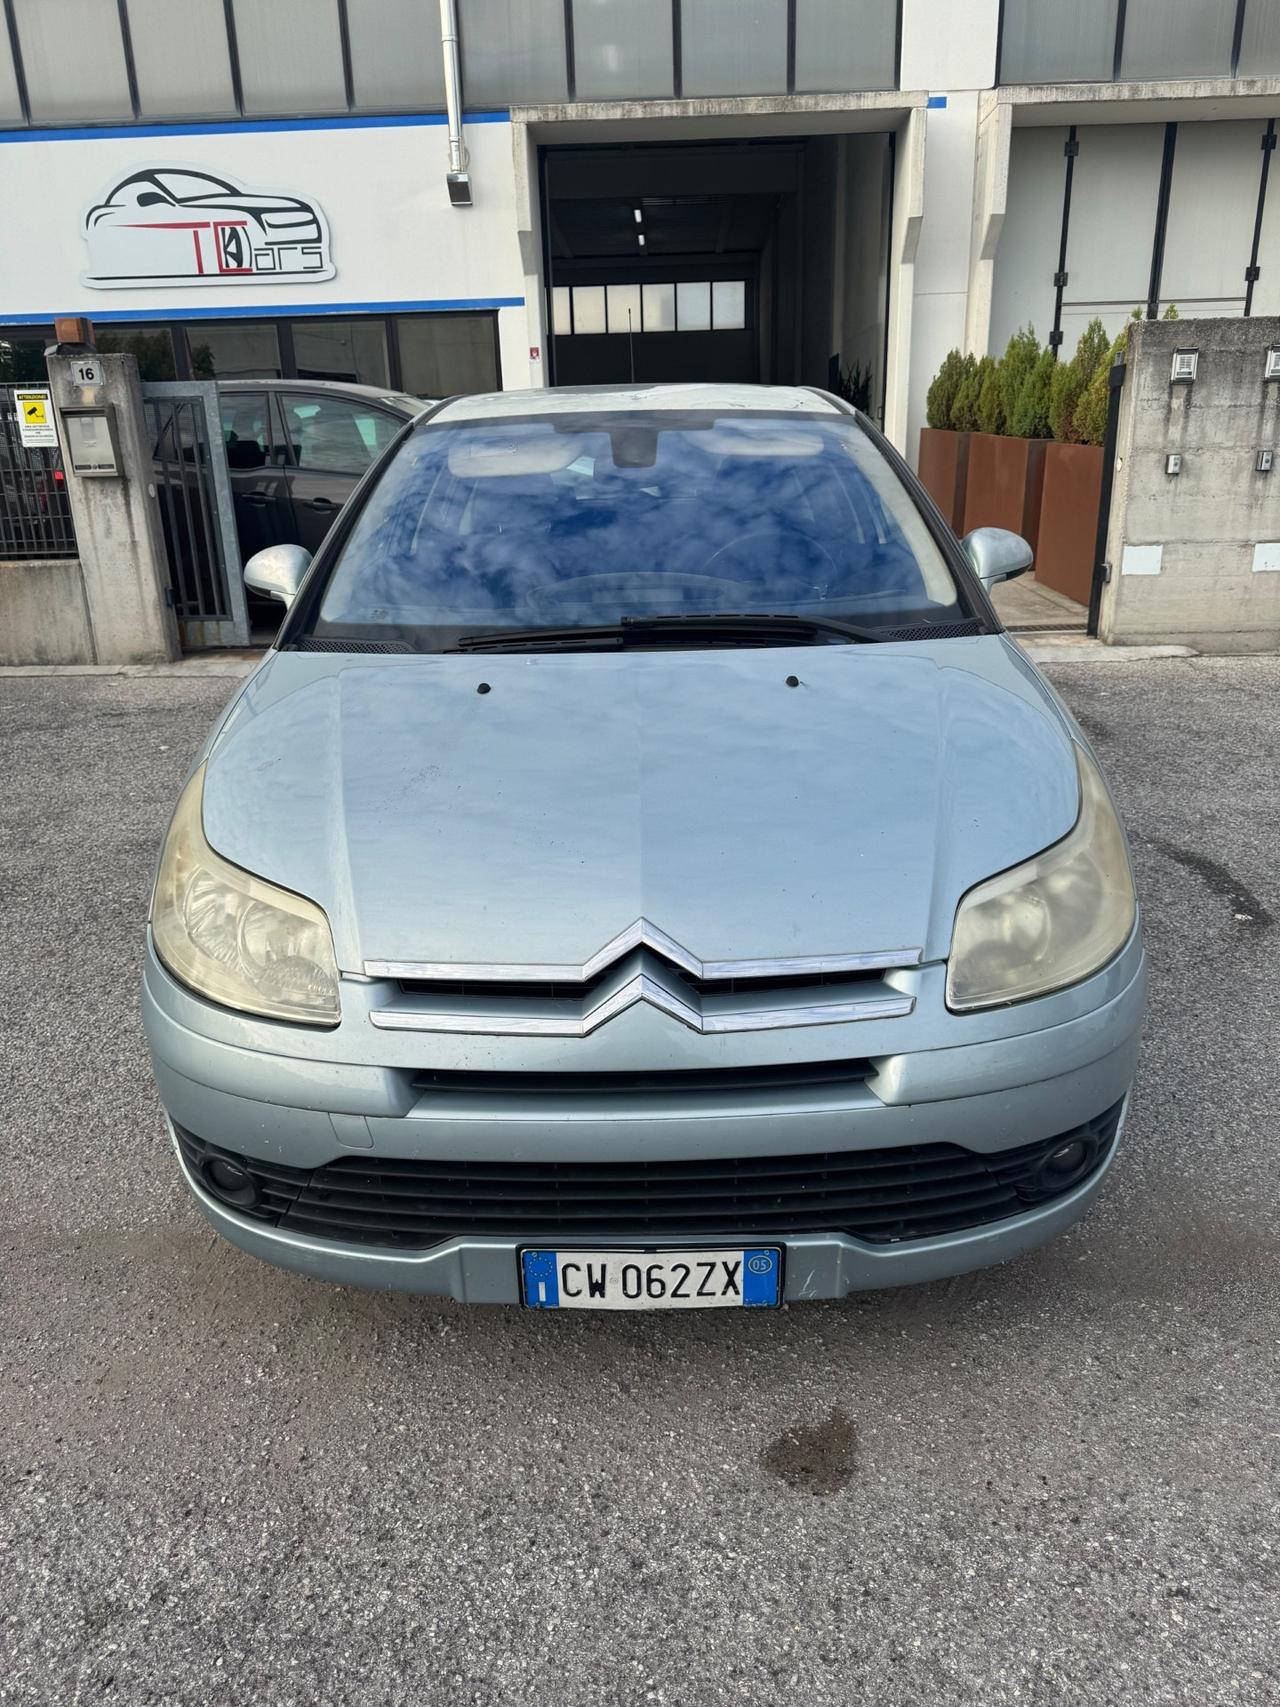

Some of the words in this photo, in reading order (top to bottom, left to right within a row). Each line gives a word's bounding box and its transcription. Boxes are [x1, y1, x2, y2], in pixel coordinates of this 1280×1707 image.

[79, 368, 94, 380] 16
[752, 1259, 768, 1271] 05
[561, 1263, 607, 1298] CW
[621, 1260, 742, 1299] 062ZX
